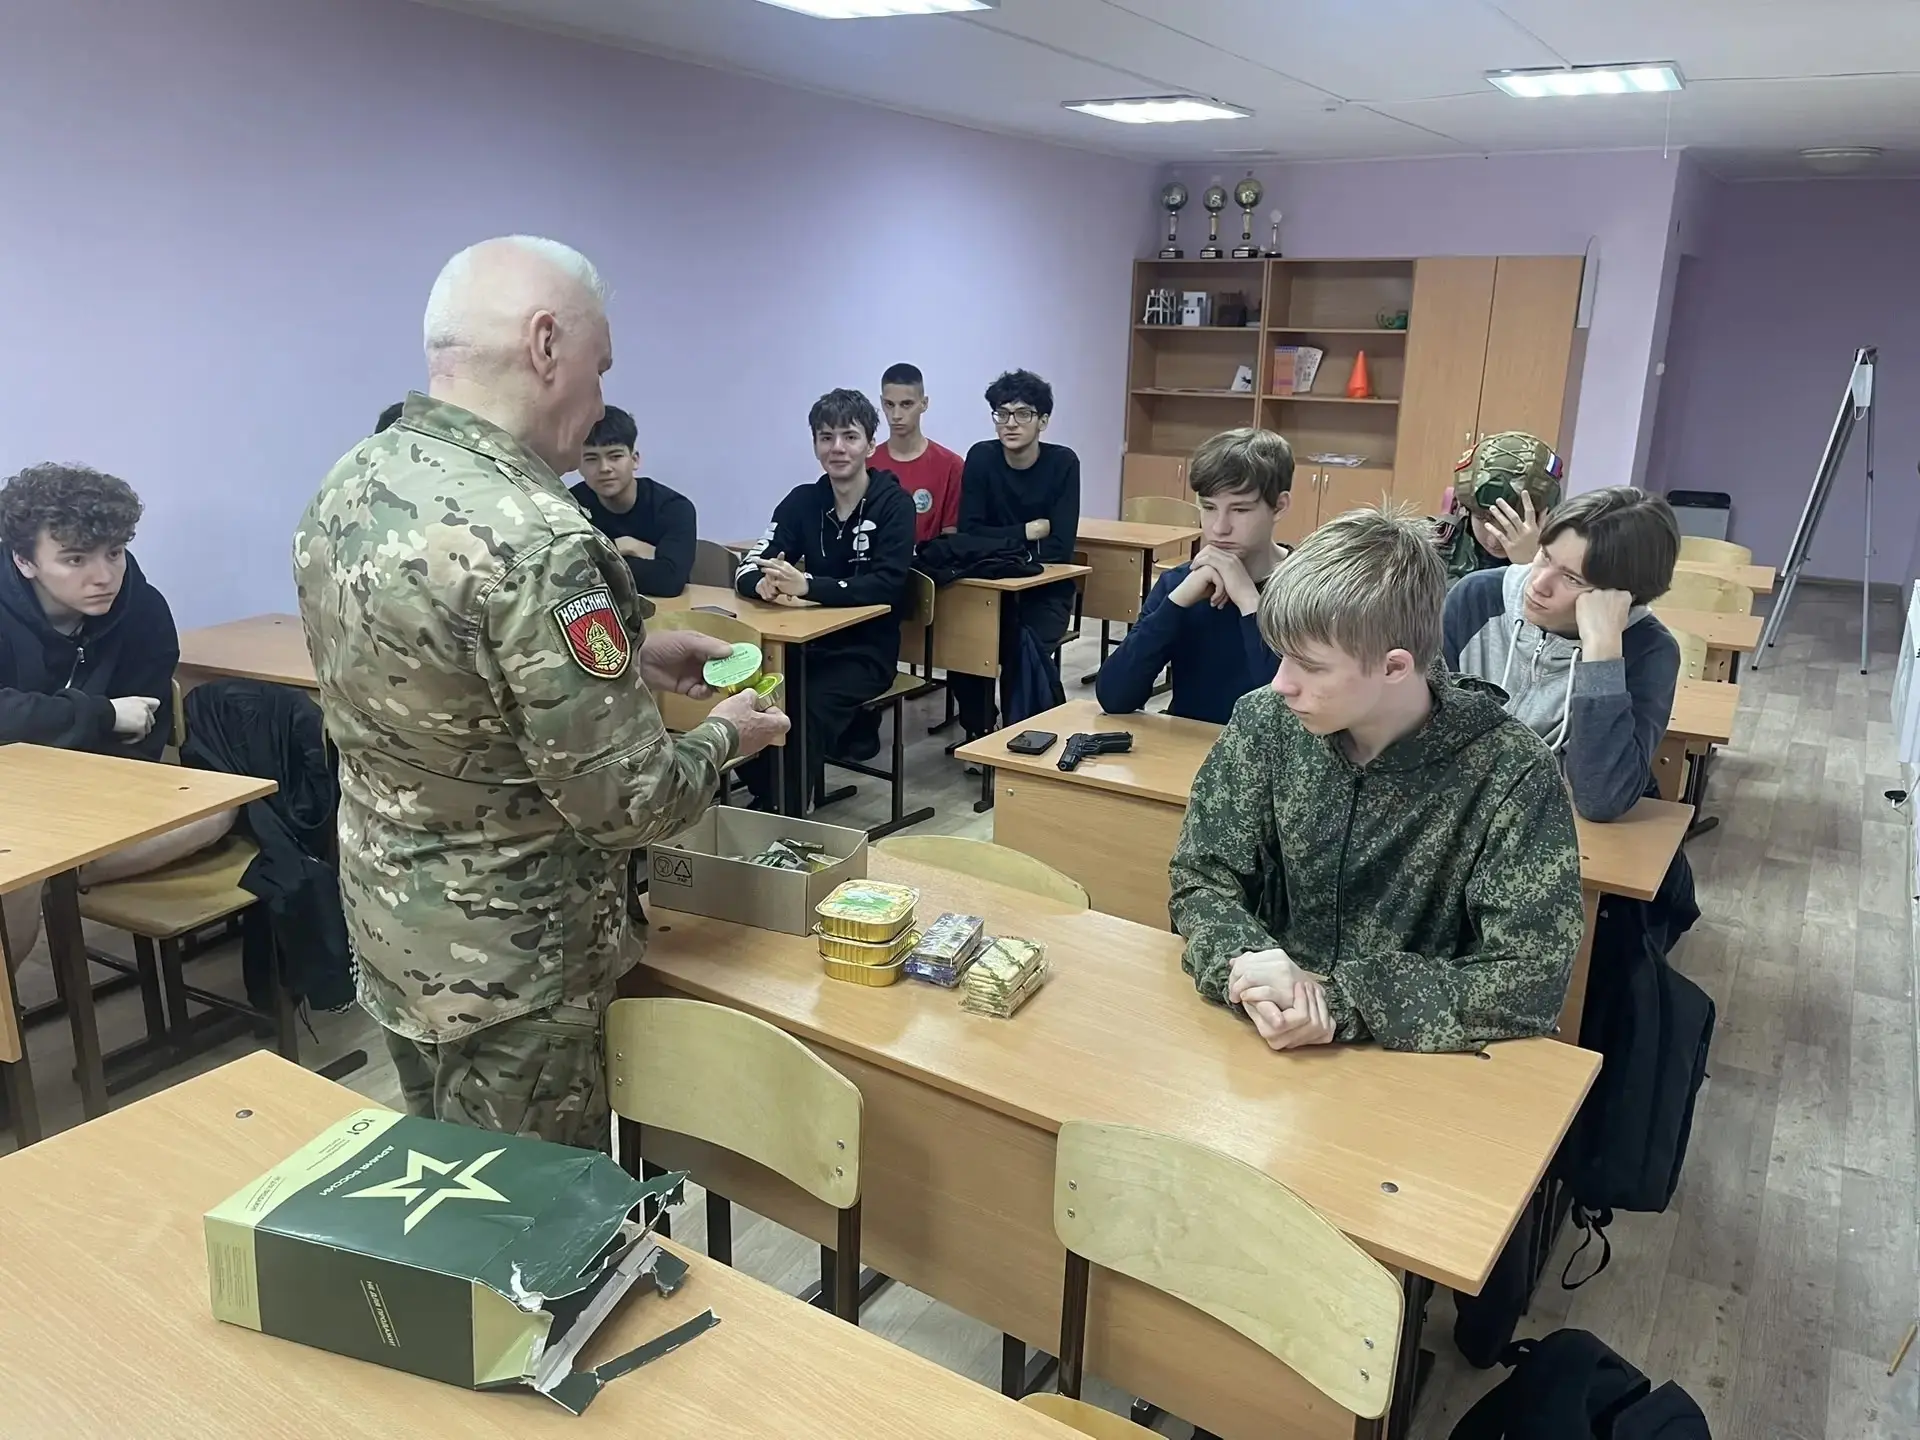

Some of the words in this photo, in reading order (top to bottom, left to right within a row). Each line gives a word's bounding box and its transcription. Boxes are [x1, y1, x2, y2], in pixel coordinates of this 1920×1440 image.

[558, 592, 610, 626] НЕВСКИЙ
[359, 1144, 395, 1170] АРМИЯ
[319, 1170, 362, 1196] РОССИИ
